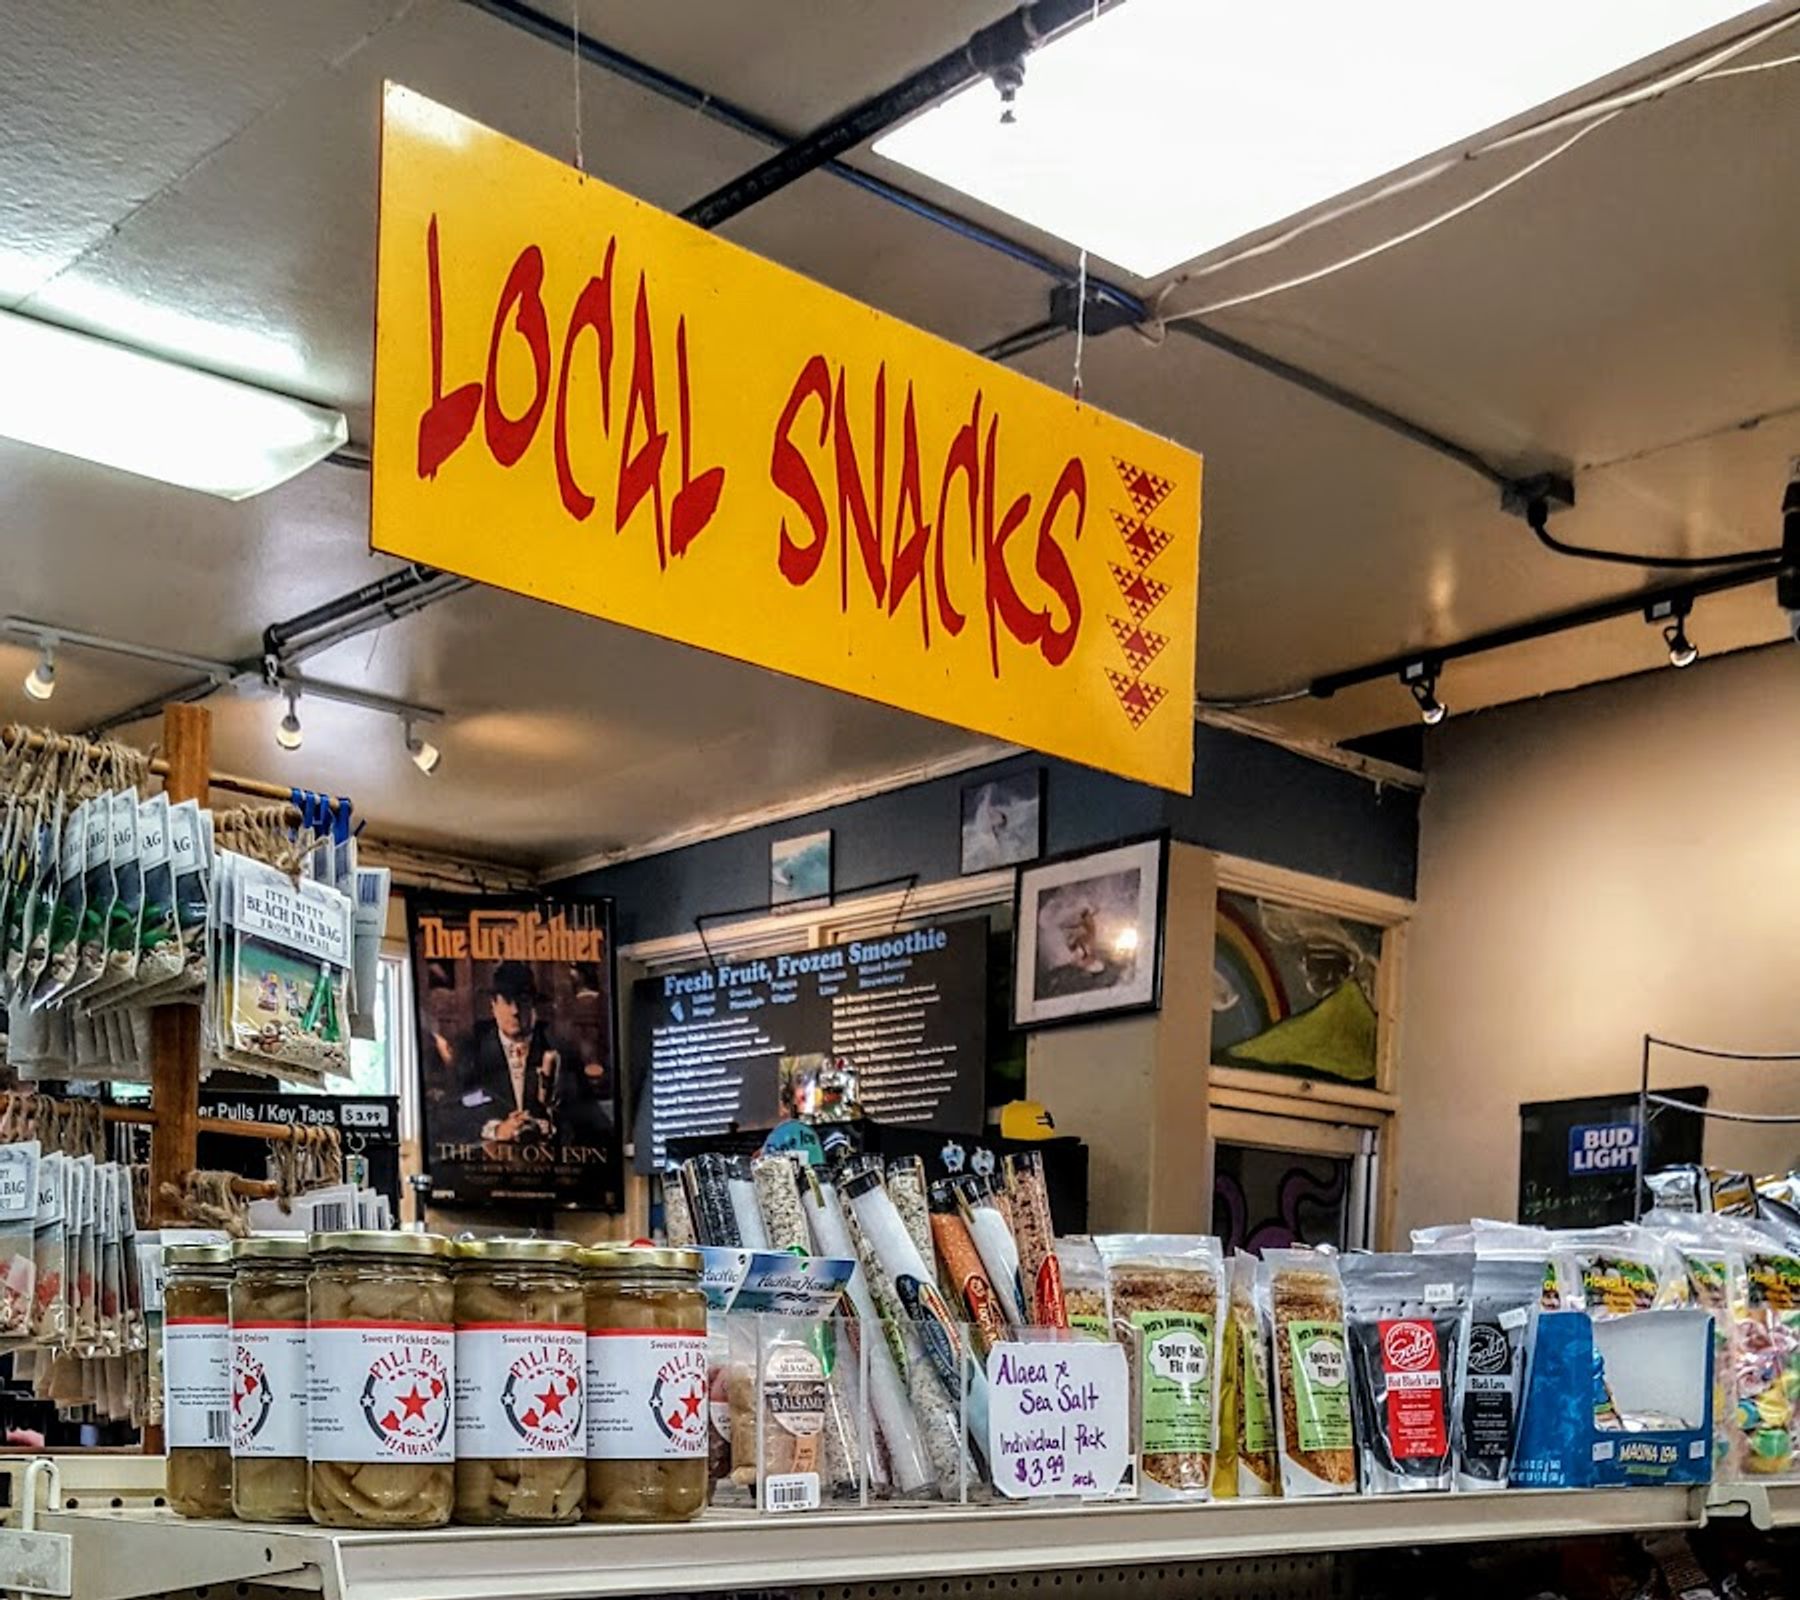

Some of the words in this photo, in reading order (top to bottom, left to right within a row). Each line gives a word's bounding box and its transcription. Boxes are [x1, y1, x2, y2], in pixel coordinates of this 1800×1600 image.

[418, 212, 725, 571] LOCAL
[771, 355, 1087, 678] SNACKS
[246, 895, 289, 922] BEACH
[290, 911, 306, 928] IN
[308, 915, 319, 932] A
[319, 918, 342, 942] BAG
[265, 889, 289, 905] ITTY
[294, 897, 326, 918] BITTY
[260, 917, 289, 935] FROM
[419, 916, 467, 960] The
[664, 971, 714, 997] Fresh
[717, 962, 773, 988] Fruit,
[777, 952, 843, 977] Frozen
[849, 928, 948, 964] Smoothie
[217, 1104, 255, 1121] Pulls
[267, 1105, 296, 1125] Key
[300, 1107, 335, 1124] Tags
[1583, 1127, 1634, 1147] BUD
[1573, 1146, 1640, 1170] LIGHT
[362, 1333, 393, 1345] Sweet
[395, 1333, 430, 1345] Pickled
[502, 1333, 533, 1345] Sweet
[535, 1333, 568, 1345] Pickled
[650, 1340, 676, 1350] Sweet
[1388, 1330, 1433, 1366] Salt
[370, 1347, 413, 1380] PILI
[509, 1347, 550, 1380] PILI
[995, 1354, 1048, 1387] Alaea
[1402, 1374, 1422, 1387] Black
[1423, 1375, 1440, 1387] Lava
[1471, 1377, 1488, 1390] Black
[1489, 1377, 1505, 1390] Lava
[1020, 1389, 1054, 1415] Sea
[1056, 1381, 1099, 1414] Salt
[1000, 1419, 1066, 1457] Individual
[1073, 1421, 1106, 1453] Pack
